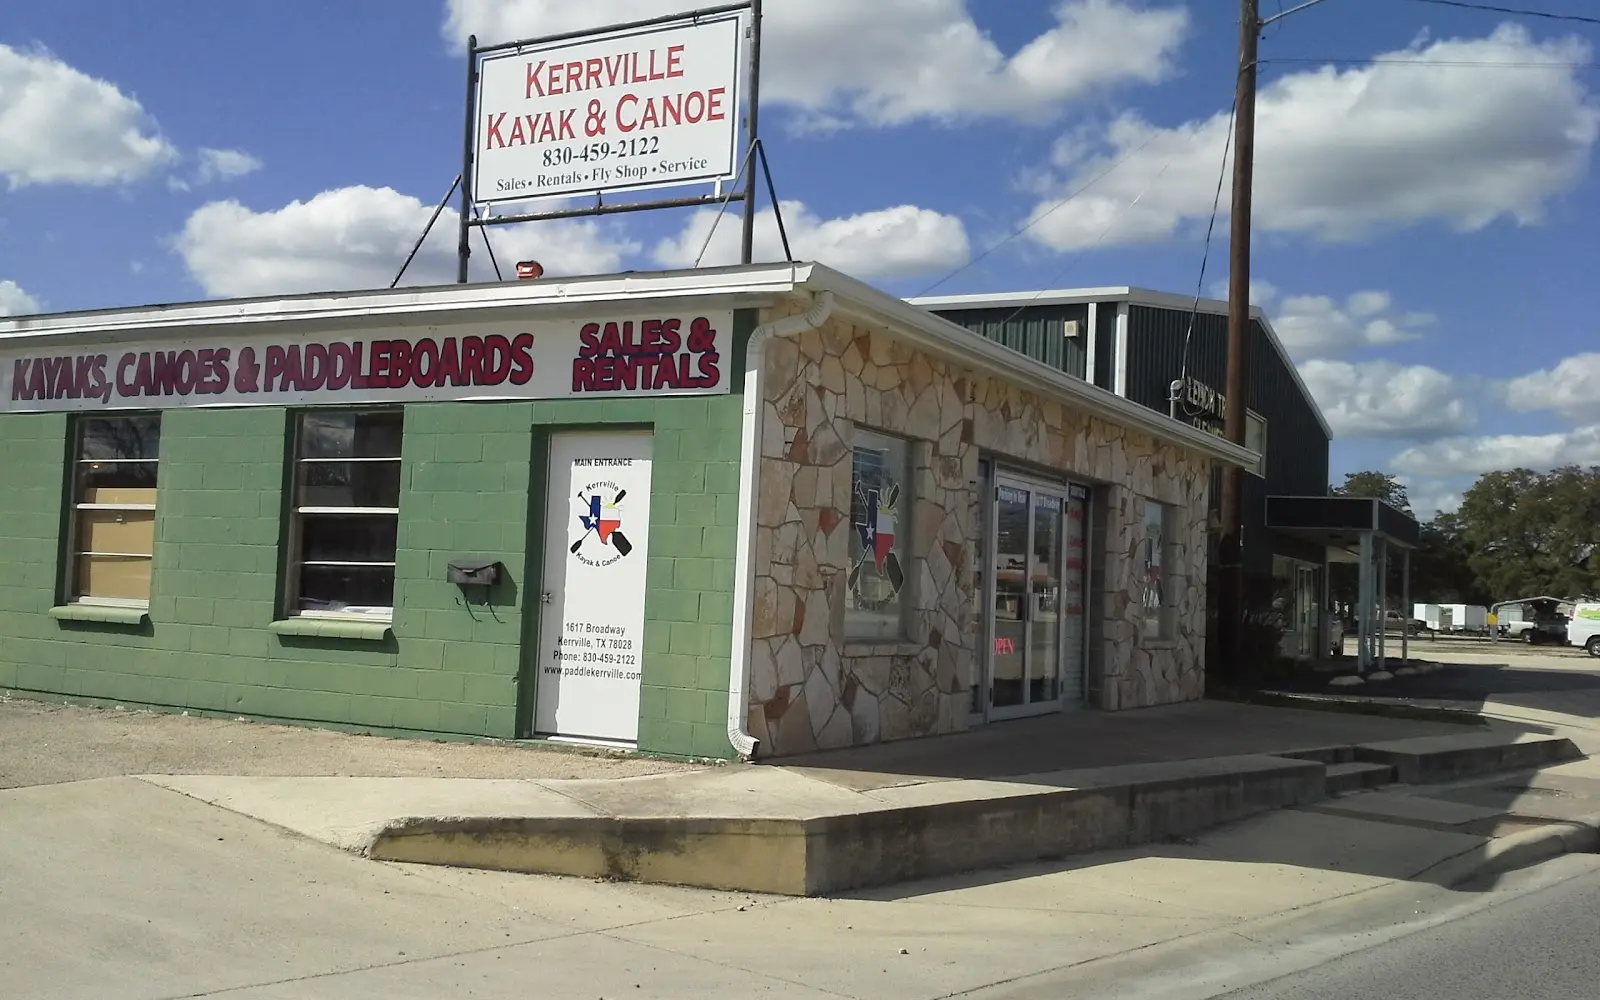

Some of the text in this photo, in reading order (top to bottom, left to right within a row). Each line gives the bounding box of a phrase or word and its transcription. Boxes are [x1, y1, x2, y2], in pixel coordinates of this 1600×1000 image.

[526, 45, 684, 99] KERRVILLE
[486, 88, 726, 150] KAYAK & CANOE
[542, 136, 660, 167] 830-459-2122
[592, 167, 612, 183] Fly
[615, 163, 647, 180] Shop
[659, 157, 707, 174] Service
[579, 316, 716, 358] SALES &
[11, 333, 534, 405] KAYAKS, CANOES & PADDLEBOARDS
[572, 350, 720, 392] RENTALS
[574, 458, 633, 467] MAIN ENTRANCE
[586, 480, 620, 492] Kerrville
[575, 551, 594, 567] Kayak
[601, 554, 621, 567] Canoe
[565, 623, 626, 636] 1617 Broadway
[557, 636, 633, 650] Kerrville, TX 78028
[553, 652, 636, 665] Phone: 830-459-2122
[544, 666, 641, 681] www.paddlekerrville.com
